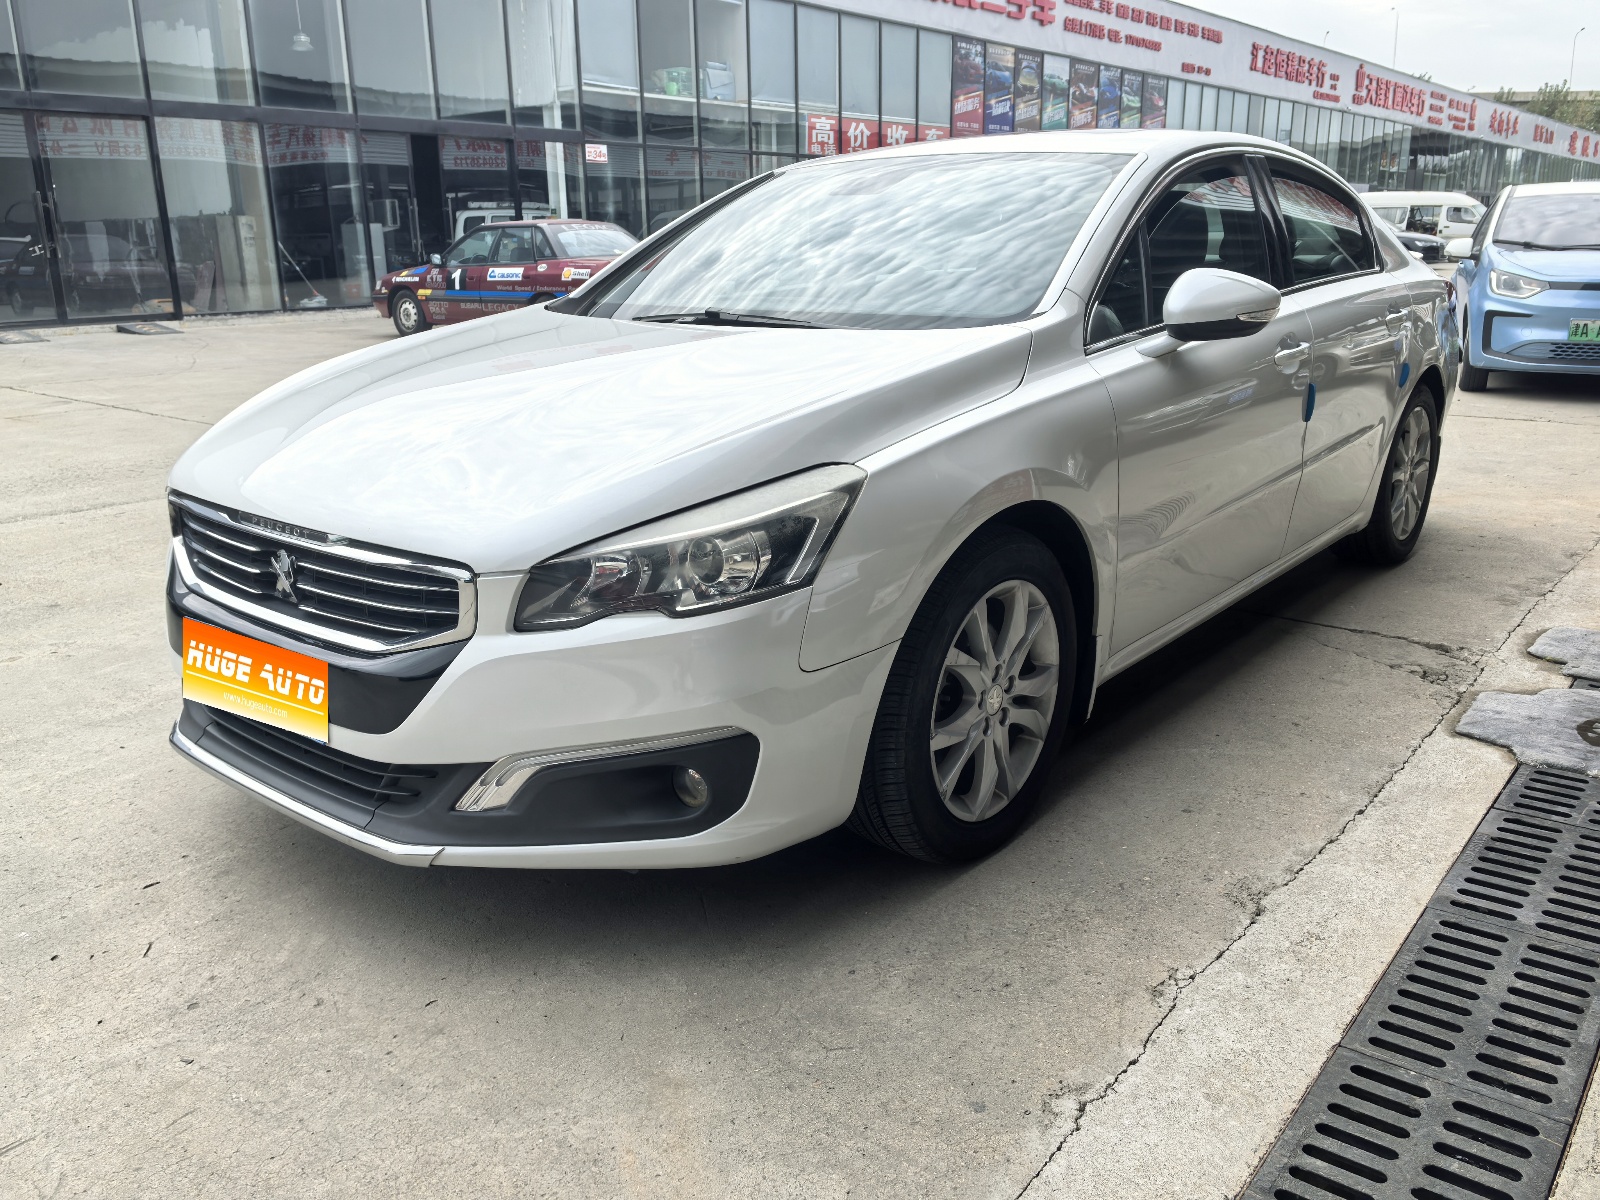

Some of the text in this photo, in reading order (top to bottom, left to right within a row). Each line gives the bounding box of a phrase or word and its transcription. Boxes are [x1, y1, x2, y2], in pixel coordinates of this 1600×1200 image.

[451, 268, 462, 290] 1
[482, 302, 519, 312] LEGACY
[252, 517, 311, 539] PEUGEOT
